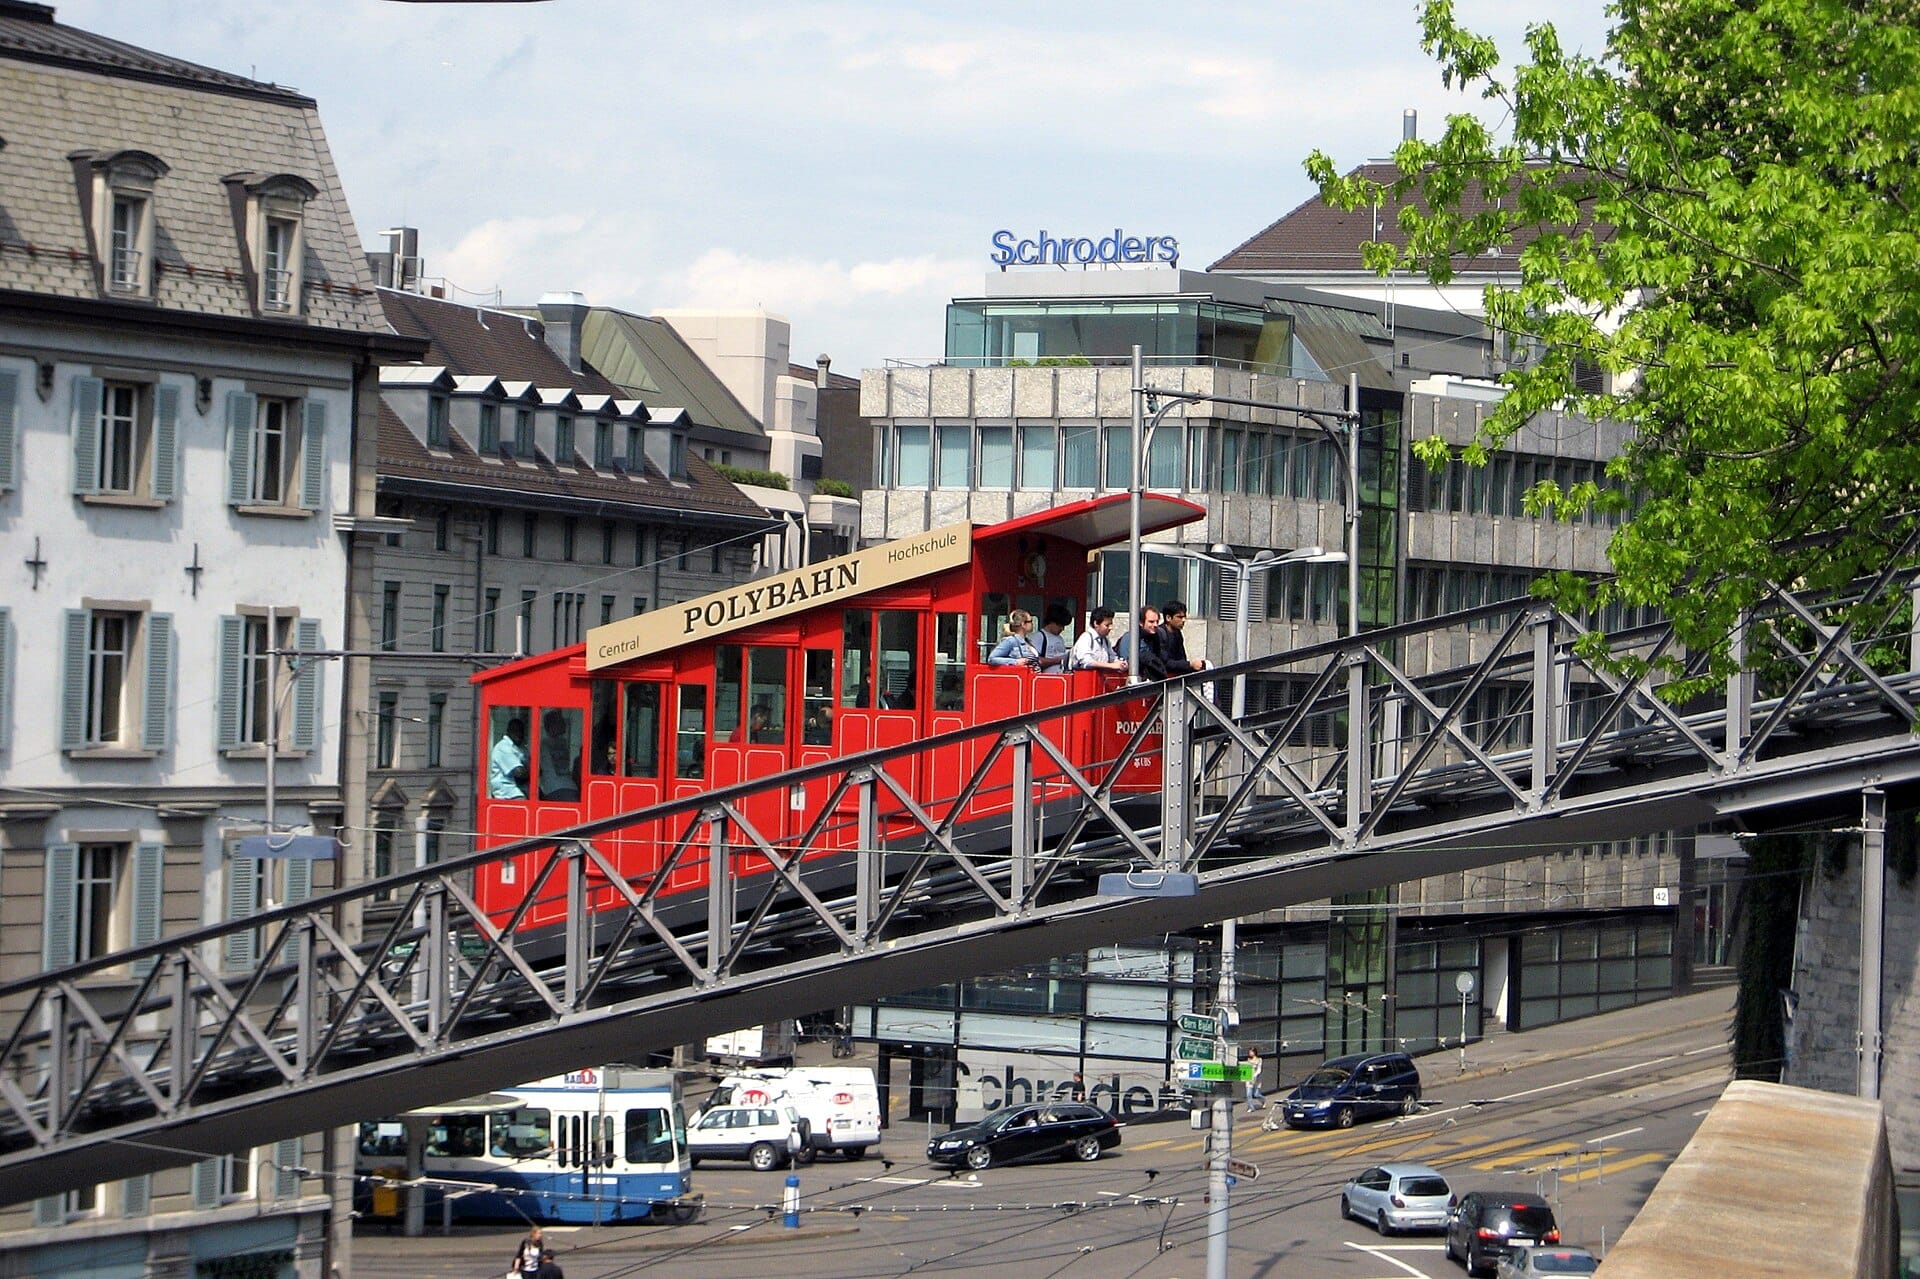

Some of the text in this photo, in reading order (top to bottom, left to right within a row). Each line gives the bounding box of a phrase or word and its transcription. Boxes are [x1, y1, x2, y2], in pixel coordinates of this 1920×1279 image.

[990, 228, 1179, 265] Schroders
[888, 533, 957, 563] Hochschule
[683, 560, 861, 634] POLYBAHN
[598, 635, 640, 659] Central
[1655, 892, 1667, 901] 42
